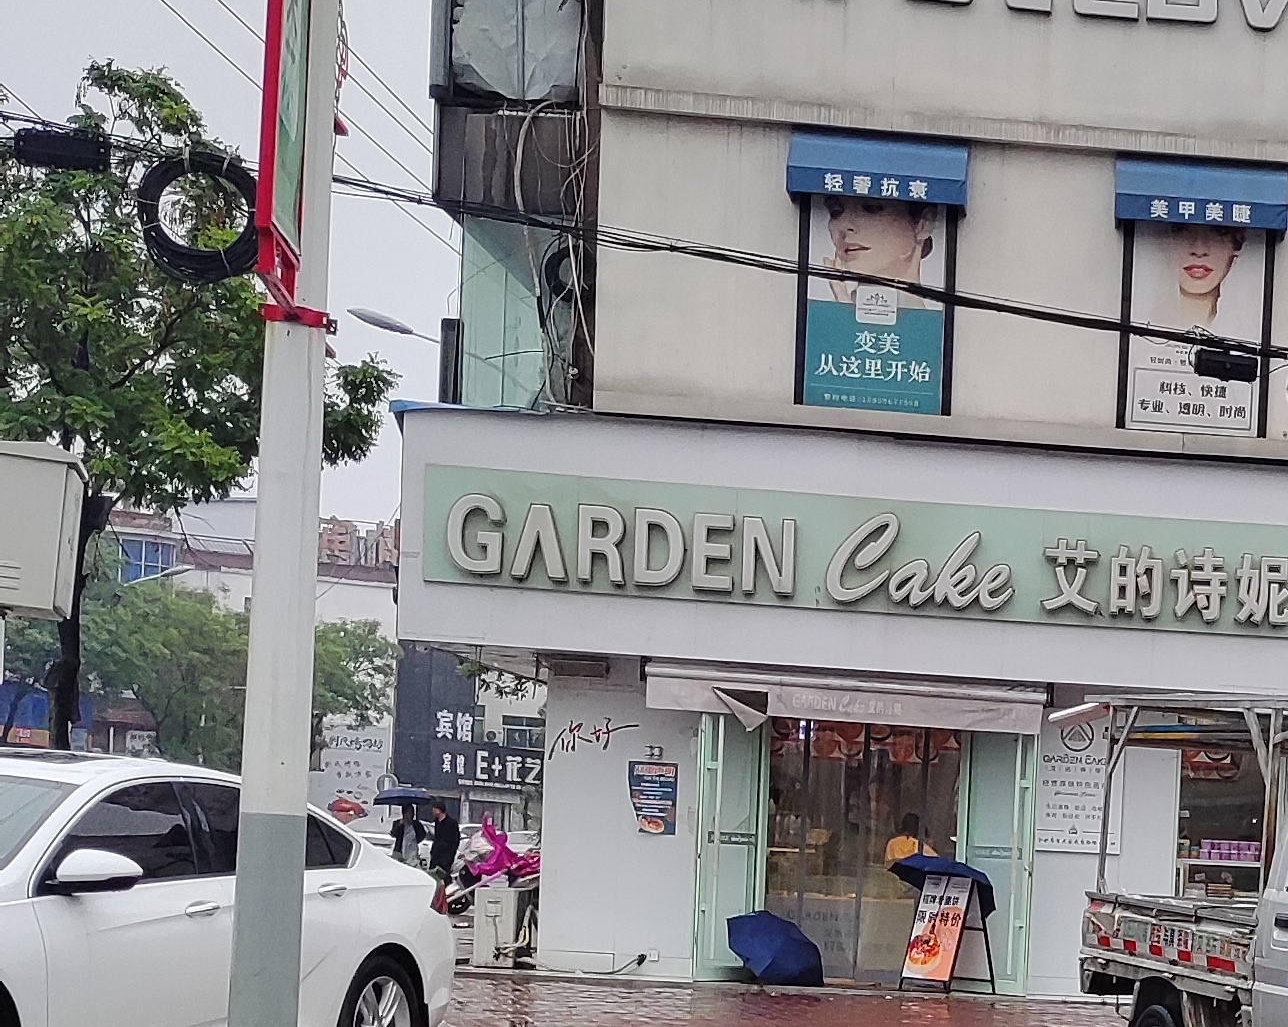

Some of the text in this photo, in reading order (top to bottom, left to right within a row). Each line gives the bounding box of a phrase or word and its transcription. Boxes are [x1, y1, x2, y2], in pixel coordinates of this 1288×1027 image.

[824, 173, 928, 199] 轻奢抗衰
[1151, 199, 1251, 224] 美甲美睫
[854, 331, 900, 355] 变美
[815, 354, 931, 382] 从这里开始
[1159, 380, 1228, 399] 科技、快捷
[1138, 399, 1246, 419] 专业、透明、时尚
[447, 493, 797, 598] GARDEN
[824, 512, 1015, 611] Cake
[435, 709, 474, 743] 宾馆
[548, 717, 639, 760] 你好
